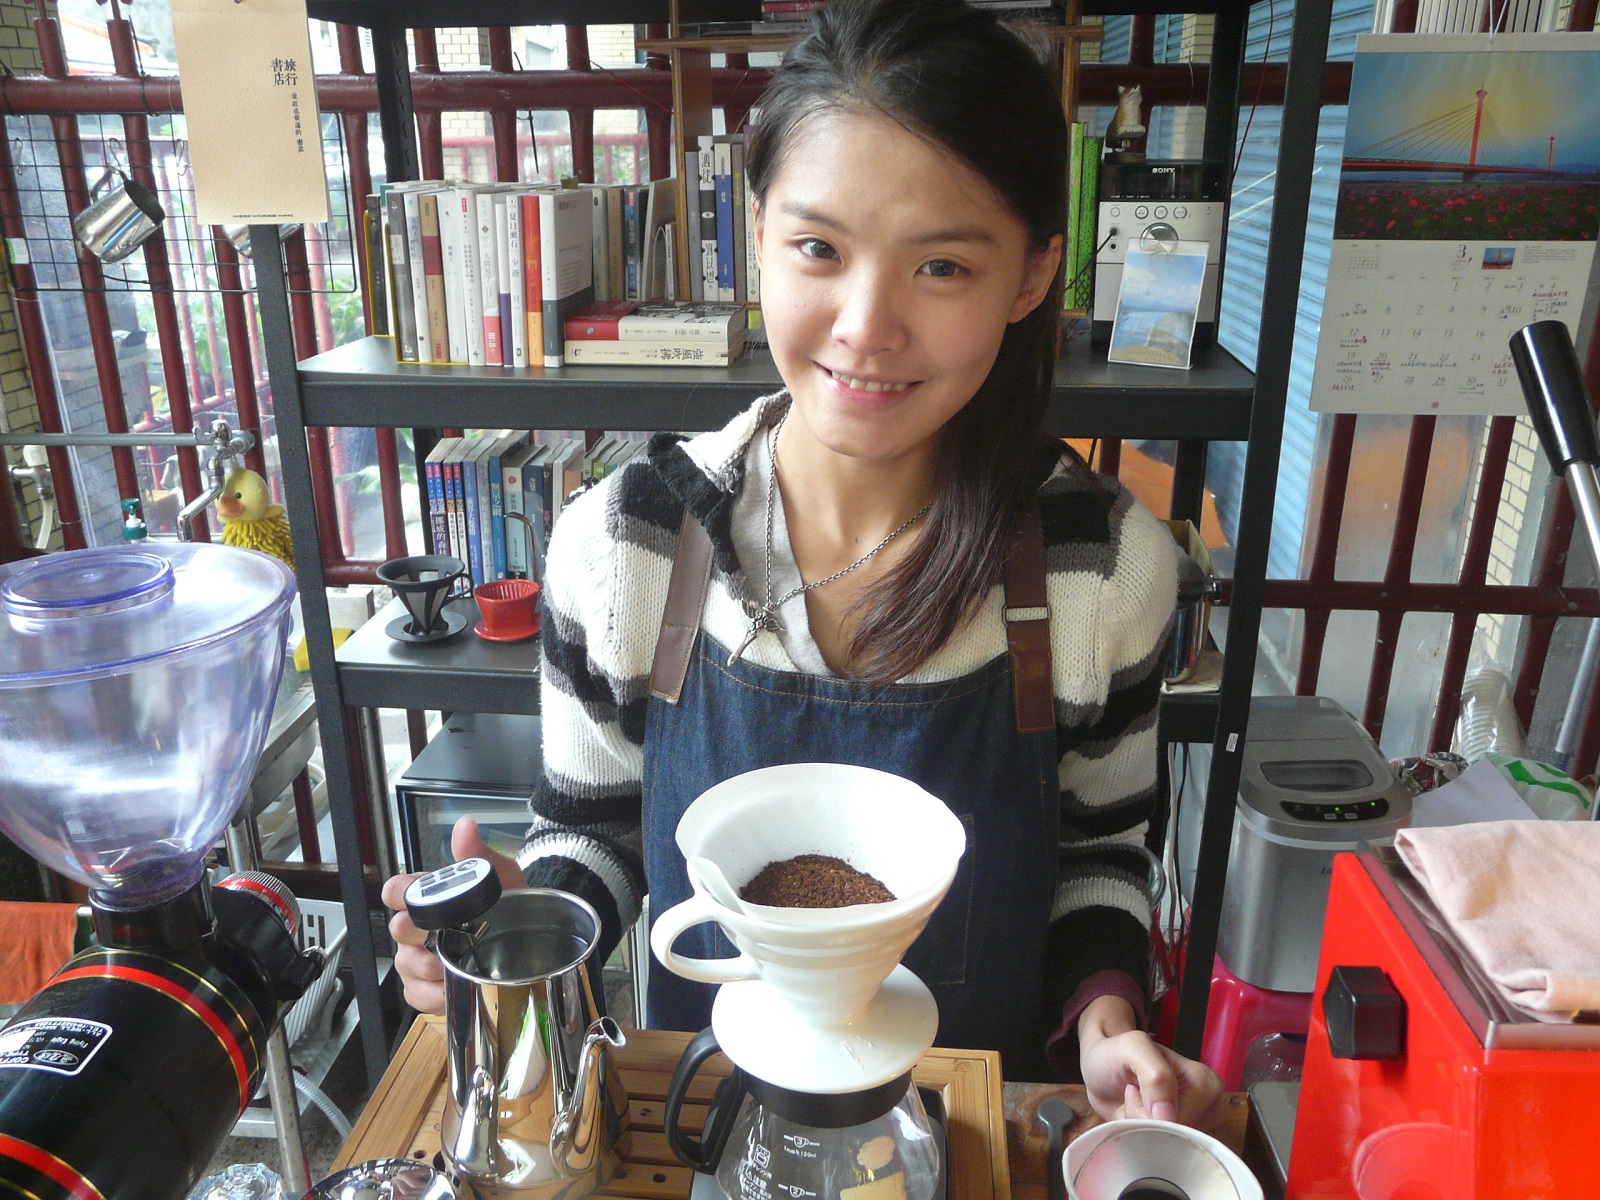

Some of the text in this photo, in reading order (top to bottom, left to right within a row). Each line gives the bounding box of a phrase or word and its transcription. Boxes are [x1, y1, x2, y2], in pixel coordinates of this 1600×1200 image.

[701, 153, 712, 184] 酒徒
[509, 212, 518, 249] 夏目漱石
[1457, 244, 1467, 259] 3
[704, 243, 715, 284] 劉以鬯
[659, 347, 705, 362] 強風吹拂
[51, 1037, 68, 1045] Eagle
[69, 1038, 88, 1049] Flying
